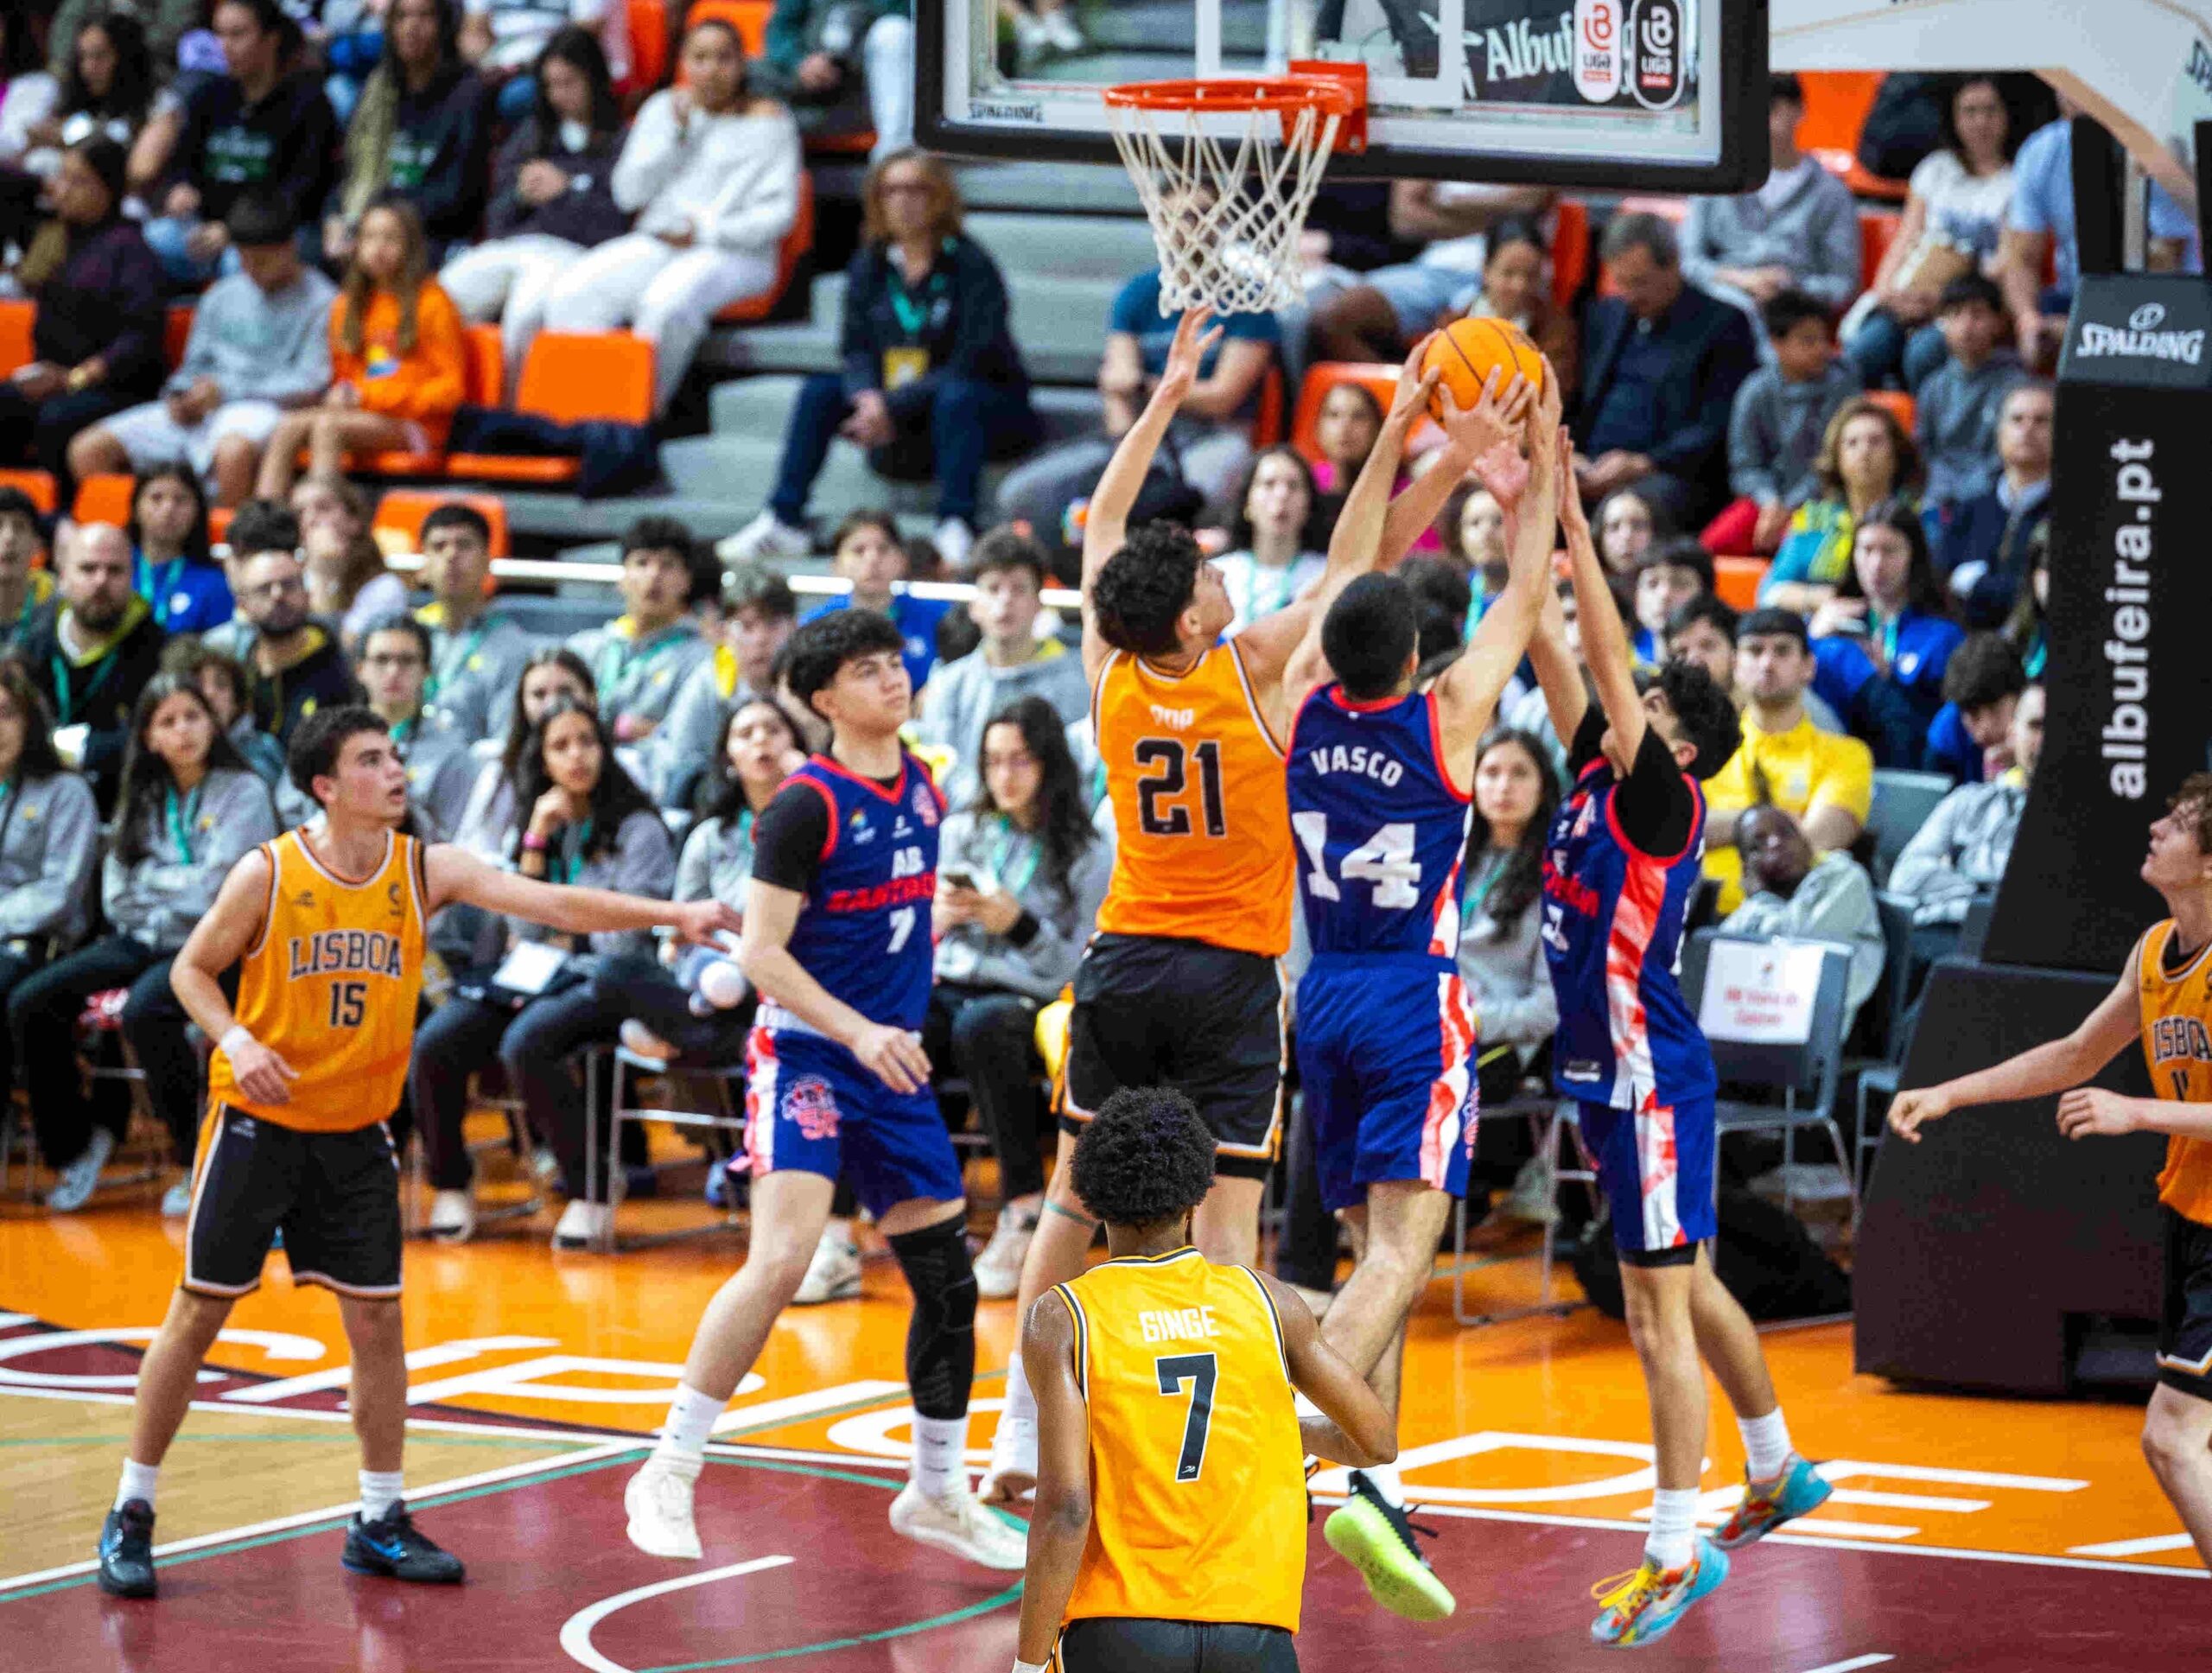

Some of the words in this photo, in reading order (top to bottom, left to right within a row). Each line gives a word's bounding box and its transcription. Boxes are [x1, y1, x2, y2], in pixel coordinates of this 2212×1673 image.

[2075, 321, 2205, 366] SPALDING
[2102, 437, 2160, 800] albufeira.pt
[1134, 735, 1227, 837] 21
[1310, 744, 1403, 788] VASCO
[1292, 811, 1421, 910] 14
[887, 906, 916, 954] 7
[288, 929, 404, 982] LISBOA
[328, 981, 369, 1027] 15
[2153, 1015, 2212, 1064] ISBOA
[1139, 1305, 1221, 1343] GINGE
[1154, 1352, 1219, 1483] 7
